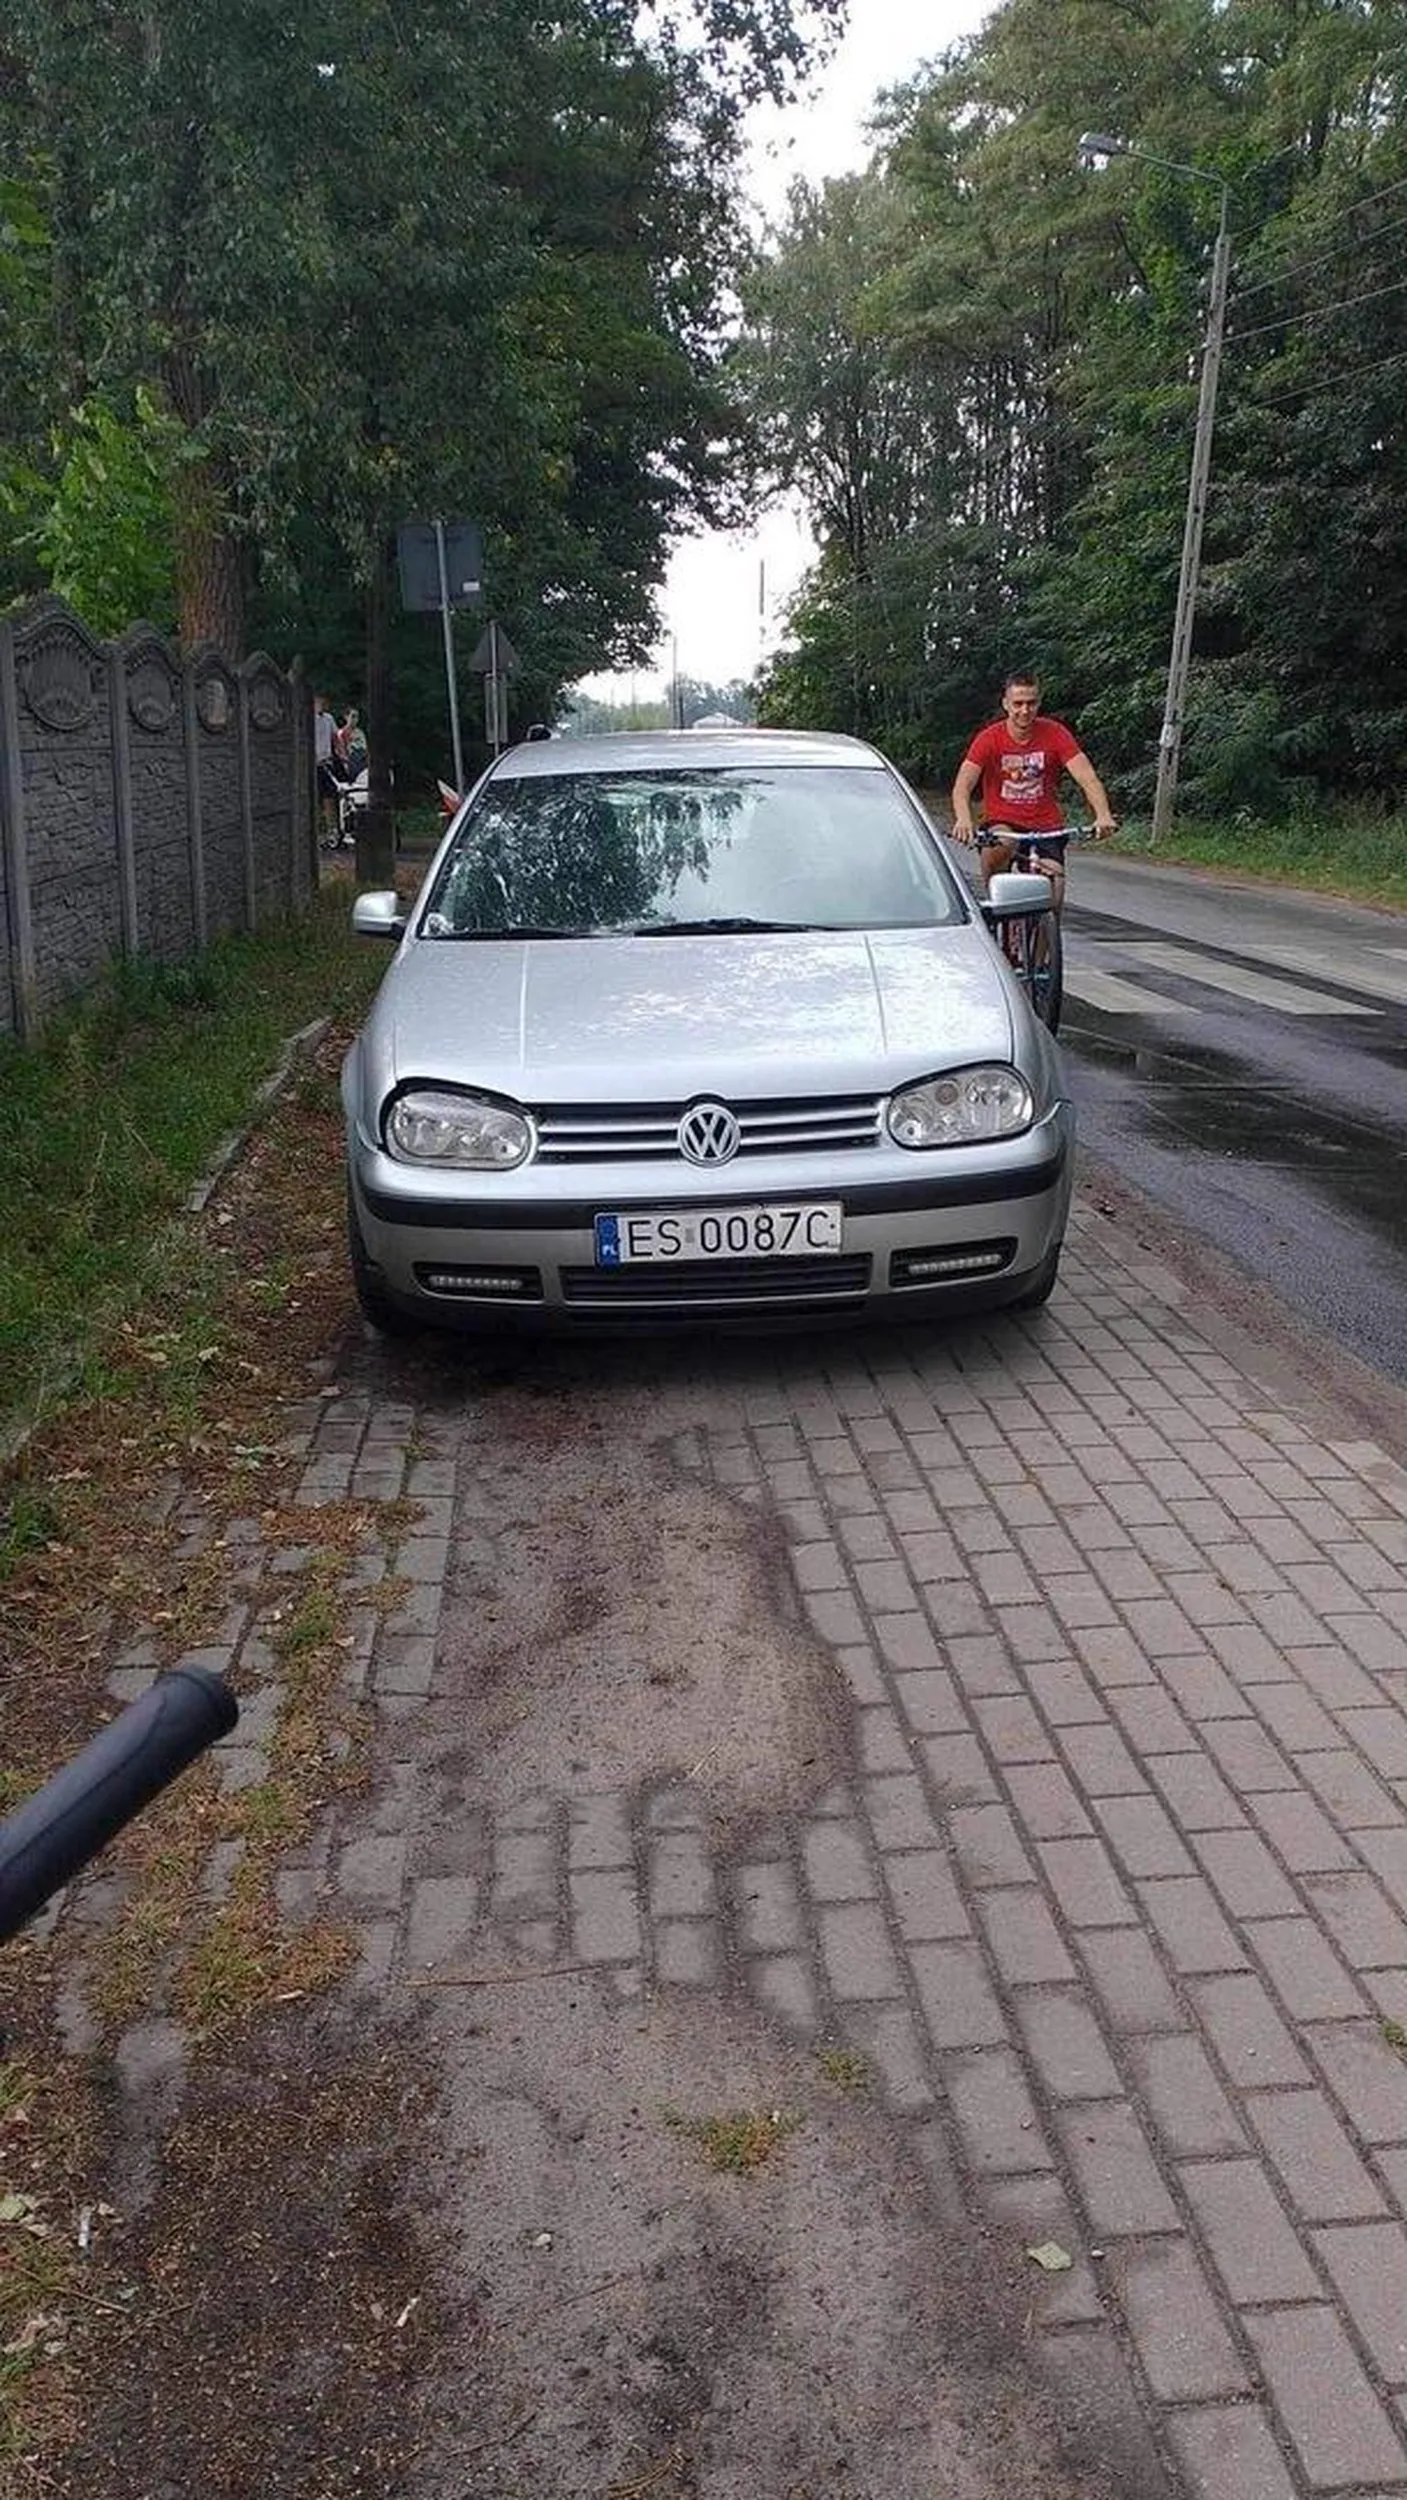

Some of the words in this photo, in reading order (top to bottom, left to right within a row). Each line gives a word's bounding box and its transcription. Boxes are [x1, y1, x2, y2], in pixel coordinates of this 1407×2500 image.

[683, 1109, 735, 1161] VW
[627, 1219, 682, 1257] ES
[700, 1210, 829, 1253] 0087C
